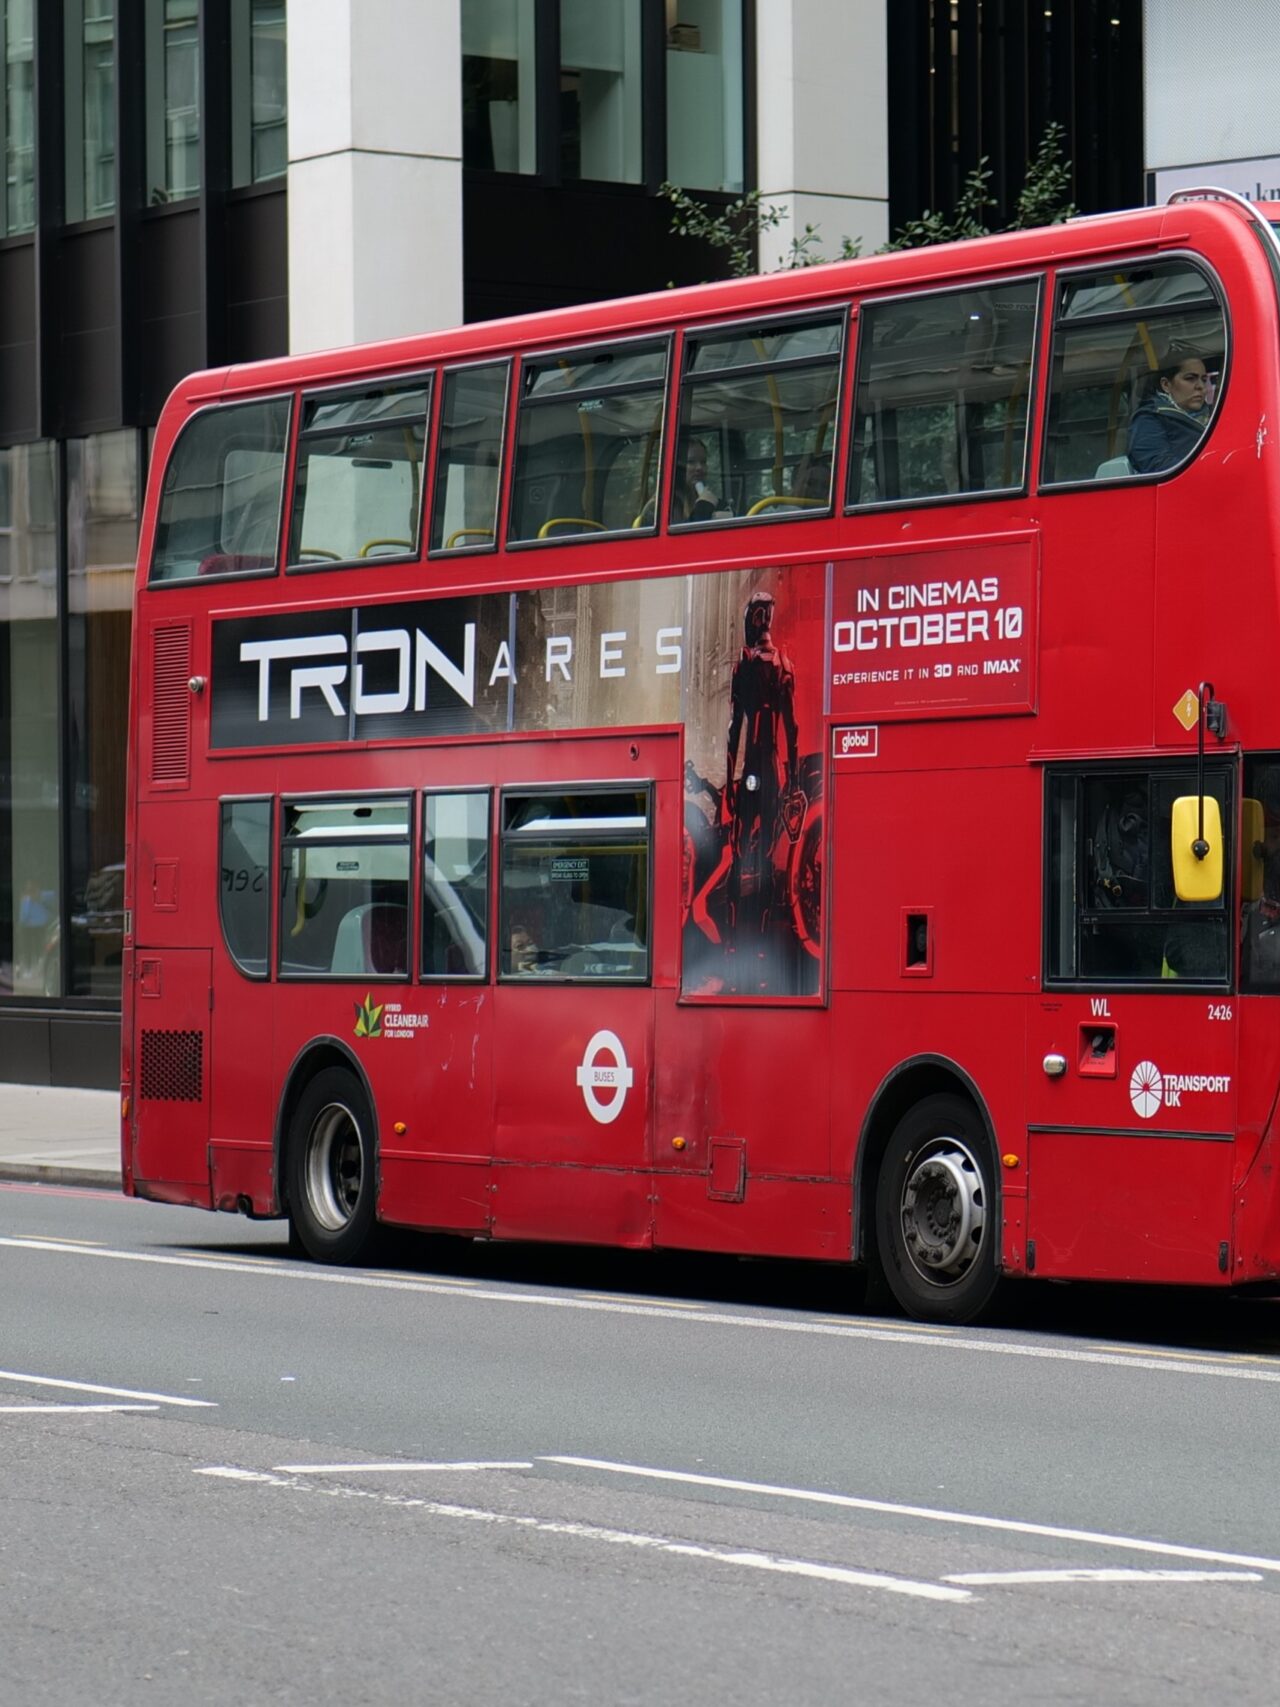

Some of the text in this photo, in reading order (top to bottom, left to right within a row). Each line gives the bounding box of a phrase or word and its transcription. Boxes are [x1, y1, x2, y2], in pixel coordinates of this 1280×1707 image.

[857, 577, 998, 613] IN CINEMAS
[833, 606, 1023, 653] OCTOBER 10
[240, 622, 476, 722] TRON
[833, 659, 1021, 685] EXPERIENCE IT IN 3D AND IMAX
[842, 731, 869, 753] global
[384, 1003, 402, 1012] HYBRID
[1090, 998, 1111, 1016] WL
[1208, 1004, 1232, 1020] 2426
[384, 1030, 414, 1038] FOR LONDON
[593, 1071, 615, 1082] BUSES
[1163, 1074, 1230, 1093] TRANSPORT
[1165, 1091, 1181, 1107] UK
